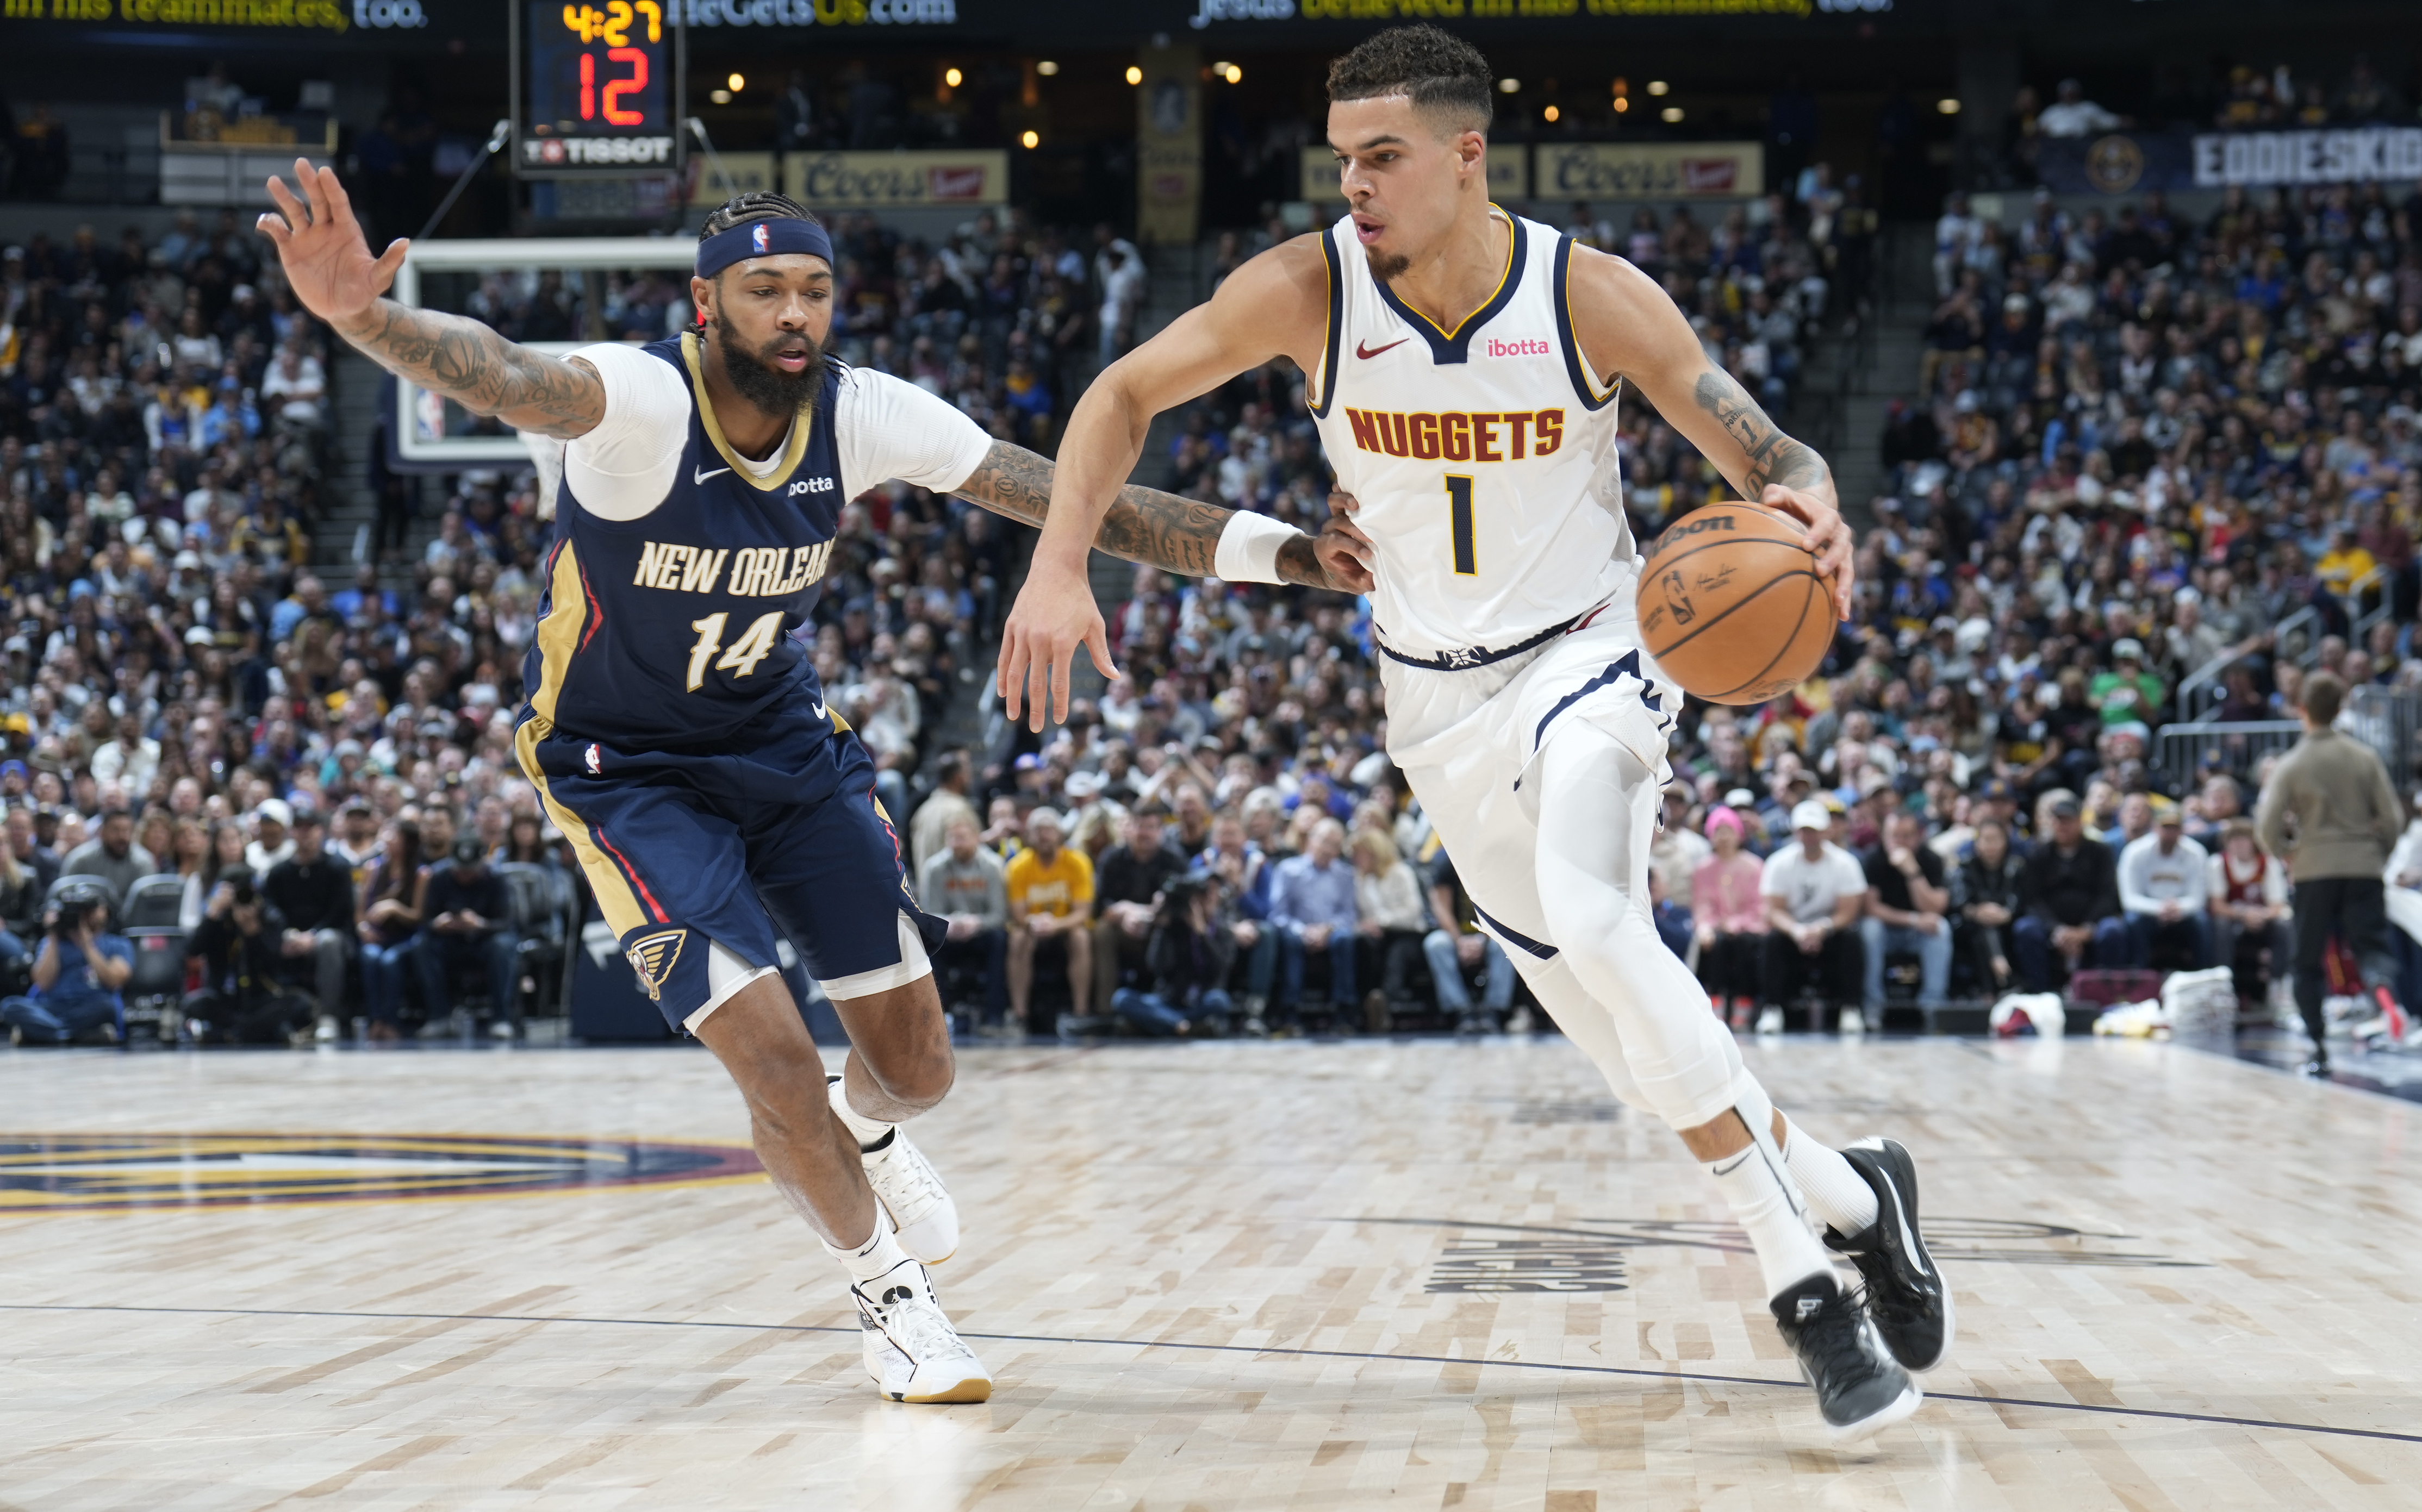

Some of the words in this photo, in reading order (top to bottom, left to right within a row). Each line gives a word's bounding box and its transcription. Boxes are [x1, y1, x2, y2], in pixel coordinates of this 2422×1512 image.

[563, 1, 661, 47] 4:27
[580, 48, 648, 126] 12
[563, 137, 675, 164] TISSOT
[1488, 339, 1549, 357] ibotta
[1343, 405, 1566, 463] NUGGETS
[1741, 419, 1758, 444] 1
[1744, 437, 1794, 501] OVE
[1443, 472, 1478, 576] 1
[632, 540, 730, 594] NEW
[686, 610, 785, 693] 14
